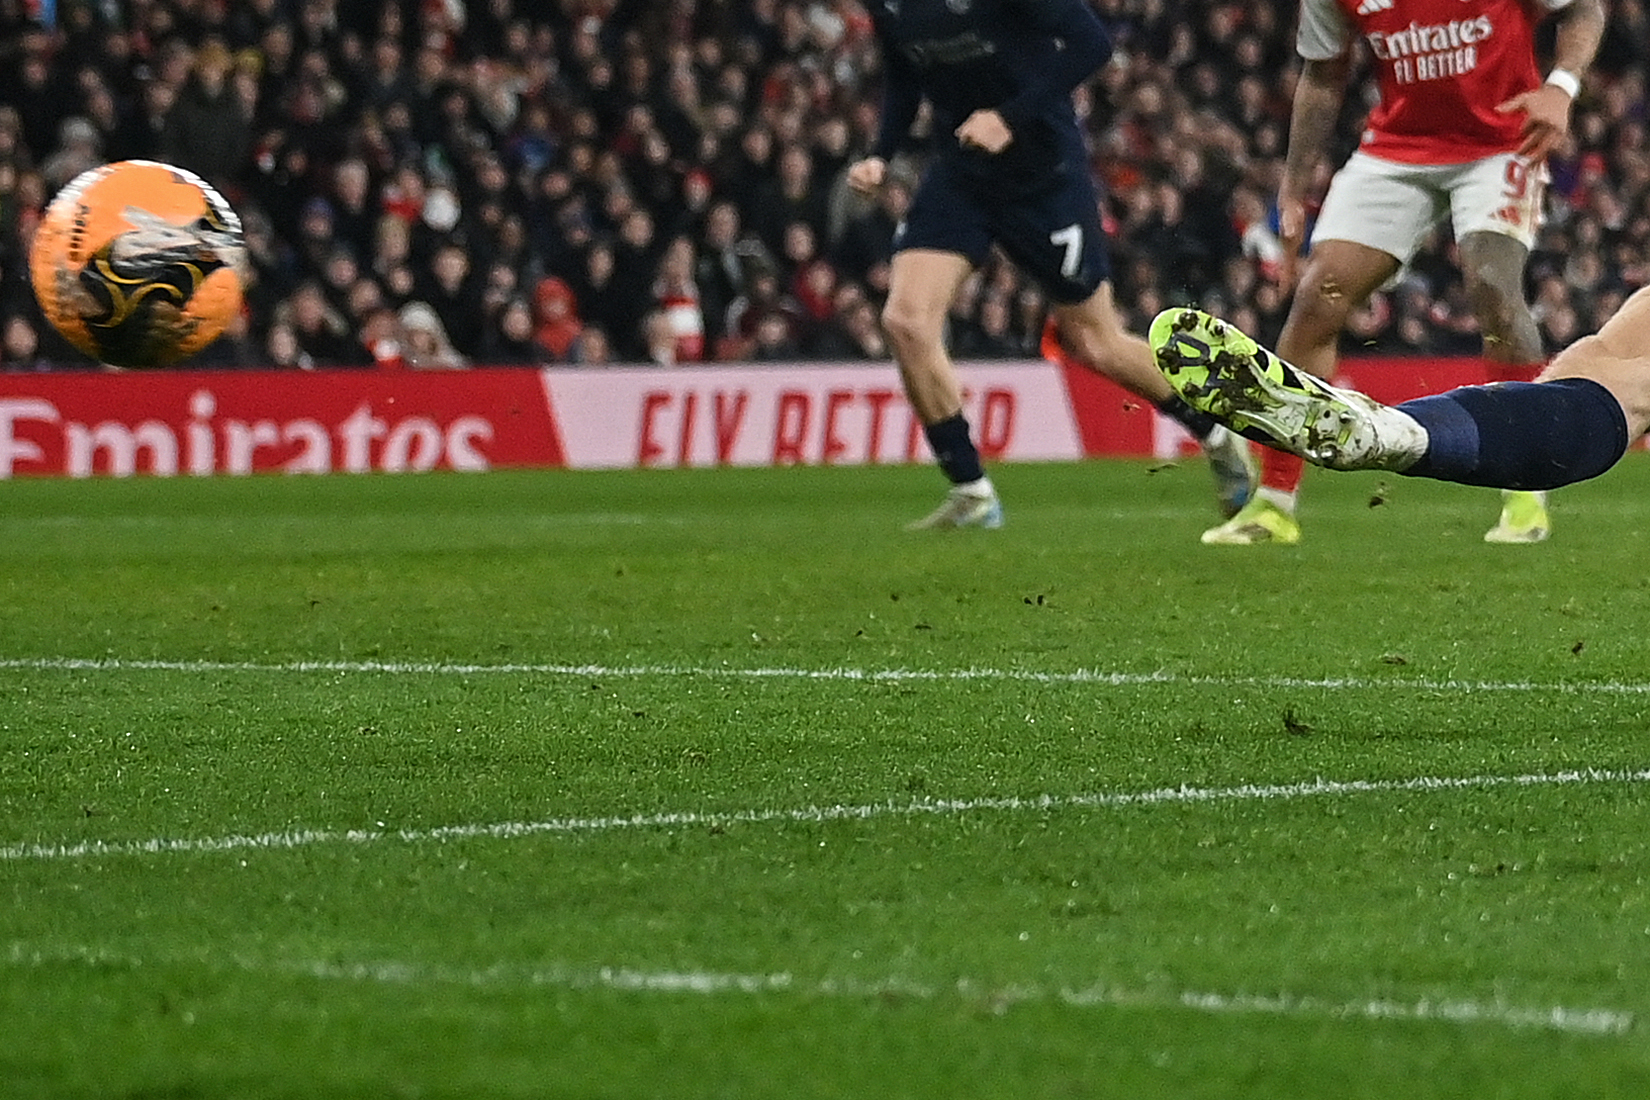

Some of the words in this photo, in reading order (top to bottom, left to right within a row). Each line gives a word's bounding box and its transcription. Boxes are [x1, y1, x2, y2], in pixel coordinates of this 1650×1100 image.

[1367, 15, 1493, 60] Emirates
[1505, 160, 1527, 199] 9
[1049, 222, 1084, 278] 7
[771, 388, 1018, 466] BETR
